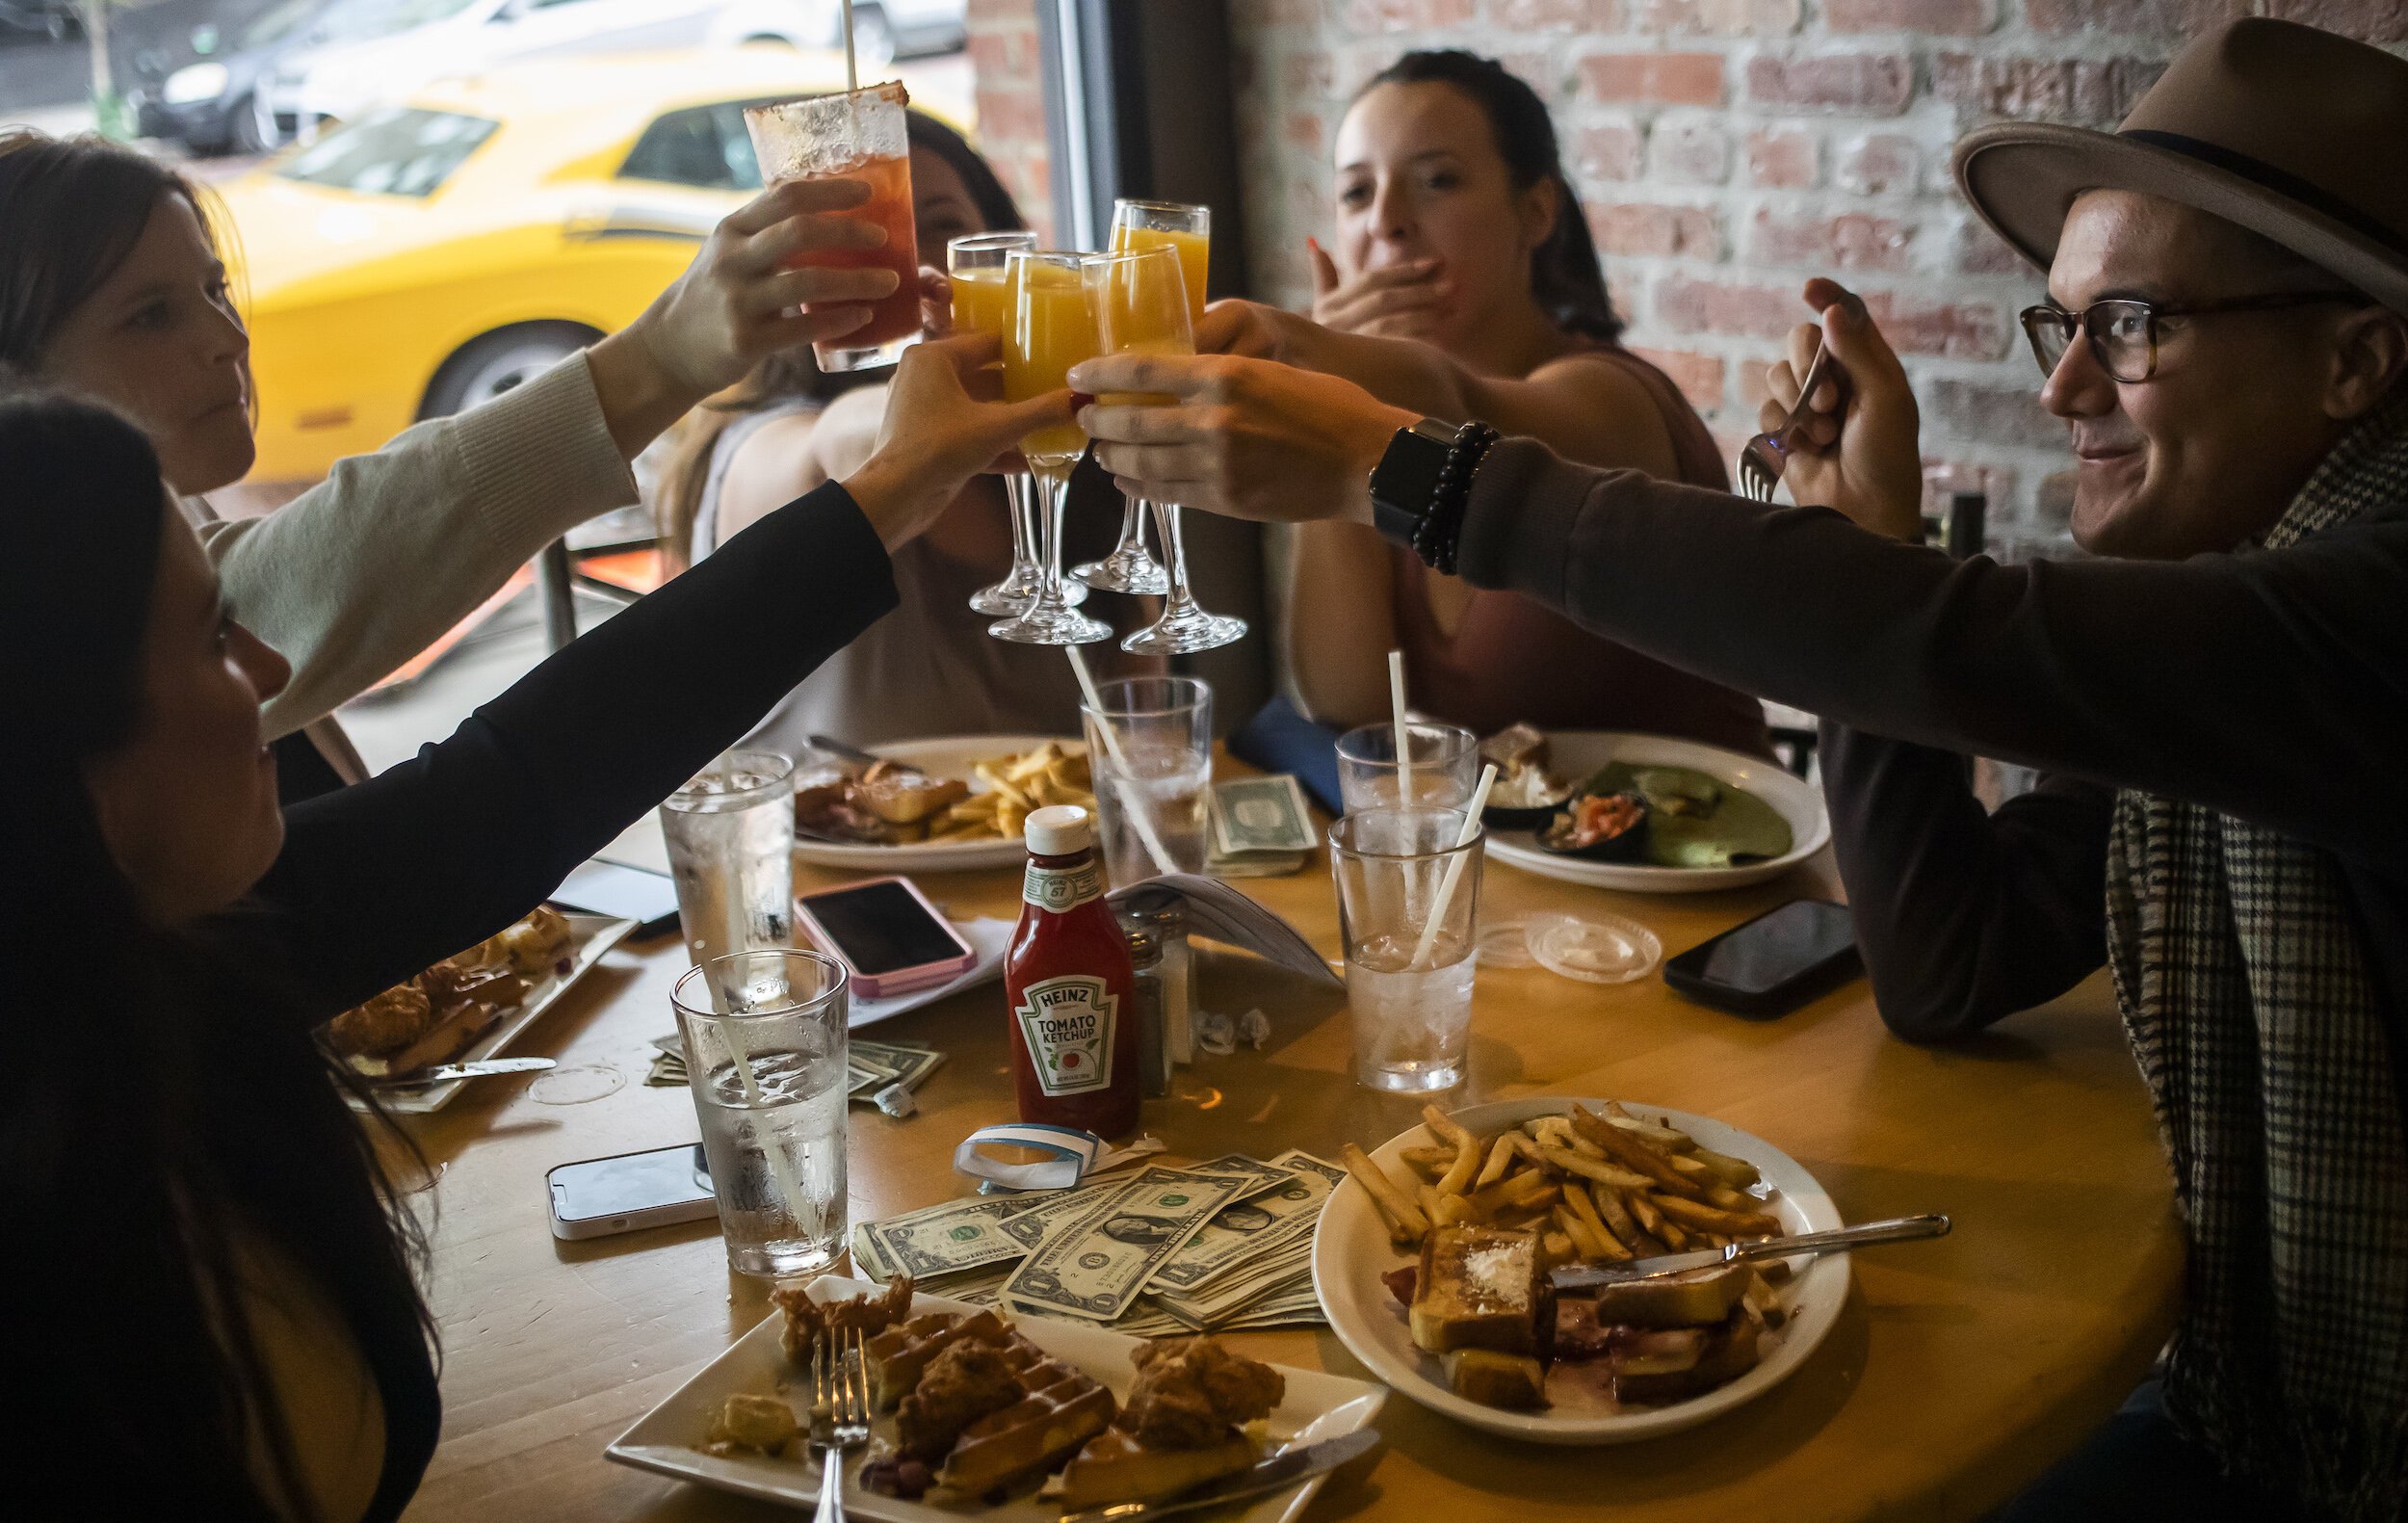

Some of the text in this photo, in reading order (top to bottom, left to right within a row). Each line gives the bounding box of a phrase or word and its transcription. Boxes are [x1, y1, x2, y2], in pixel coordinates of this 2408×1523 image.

[1040, 988, 1088, 1008] HEINZ
[1037, 1014, 1096, 1034] TOMATO
[1043, 1028, 1095, 1043] KETCHUP
